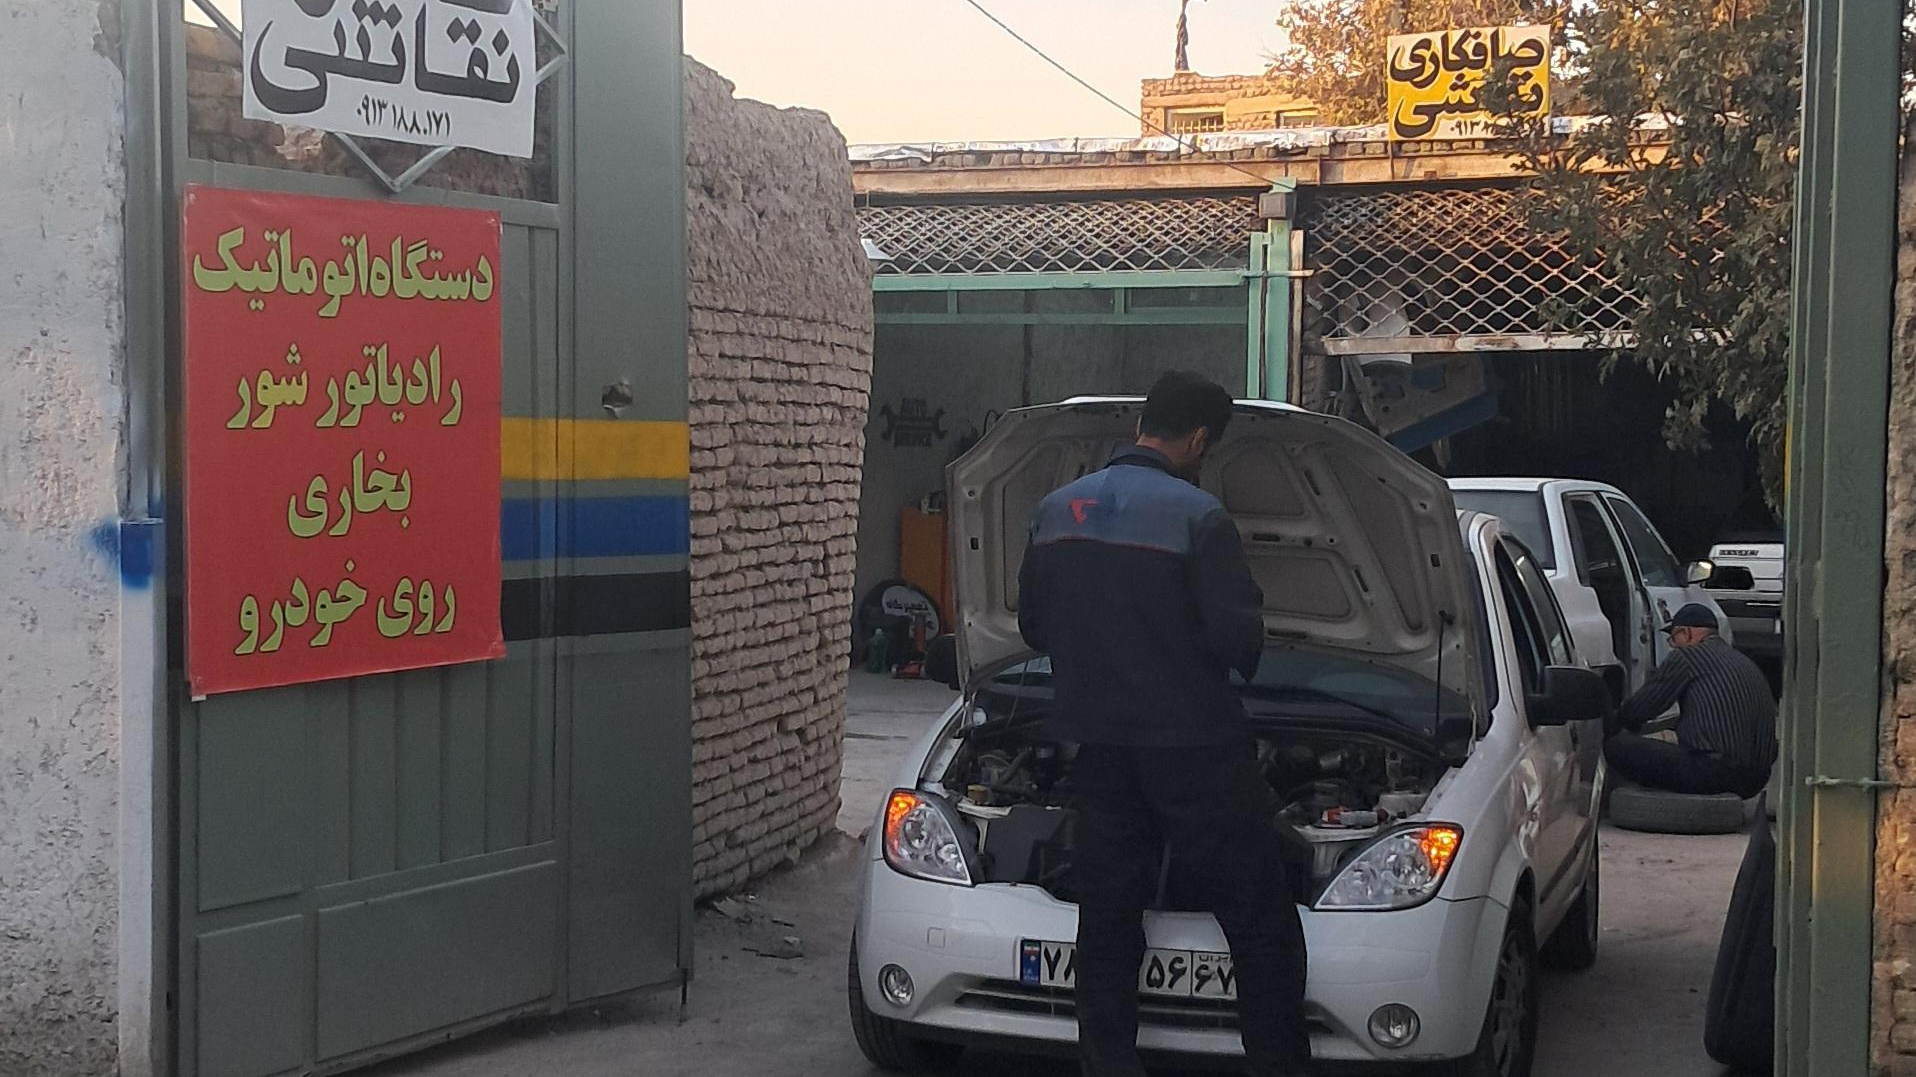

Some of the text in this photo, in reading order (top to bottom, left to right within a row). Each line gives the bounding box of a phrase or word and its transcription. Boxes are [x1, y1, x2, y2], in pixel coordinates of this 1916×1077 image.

[251, 0, 520, 114] نقاشی
[1389, 27, 1544, 89] صافکاری
[1394, 71, 1543, 138] نقشی
[370, 237, 494, 302] دستگاه
[225, 342, 463, 429] رادیاتور شور
[287, 450, 411, 537] بخاری
[234, 559, 456, 655] روی خودرو
